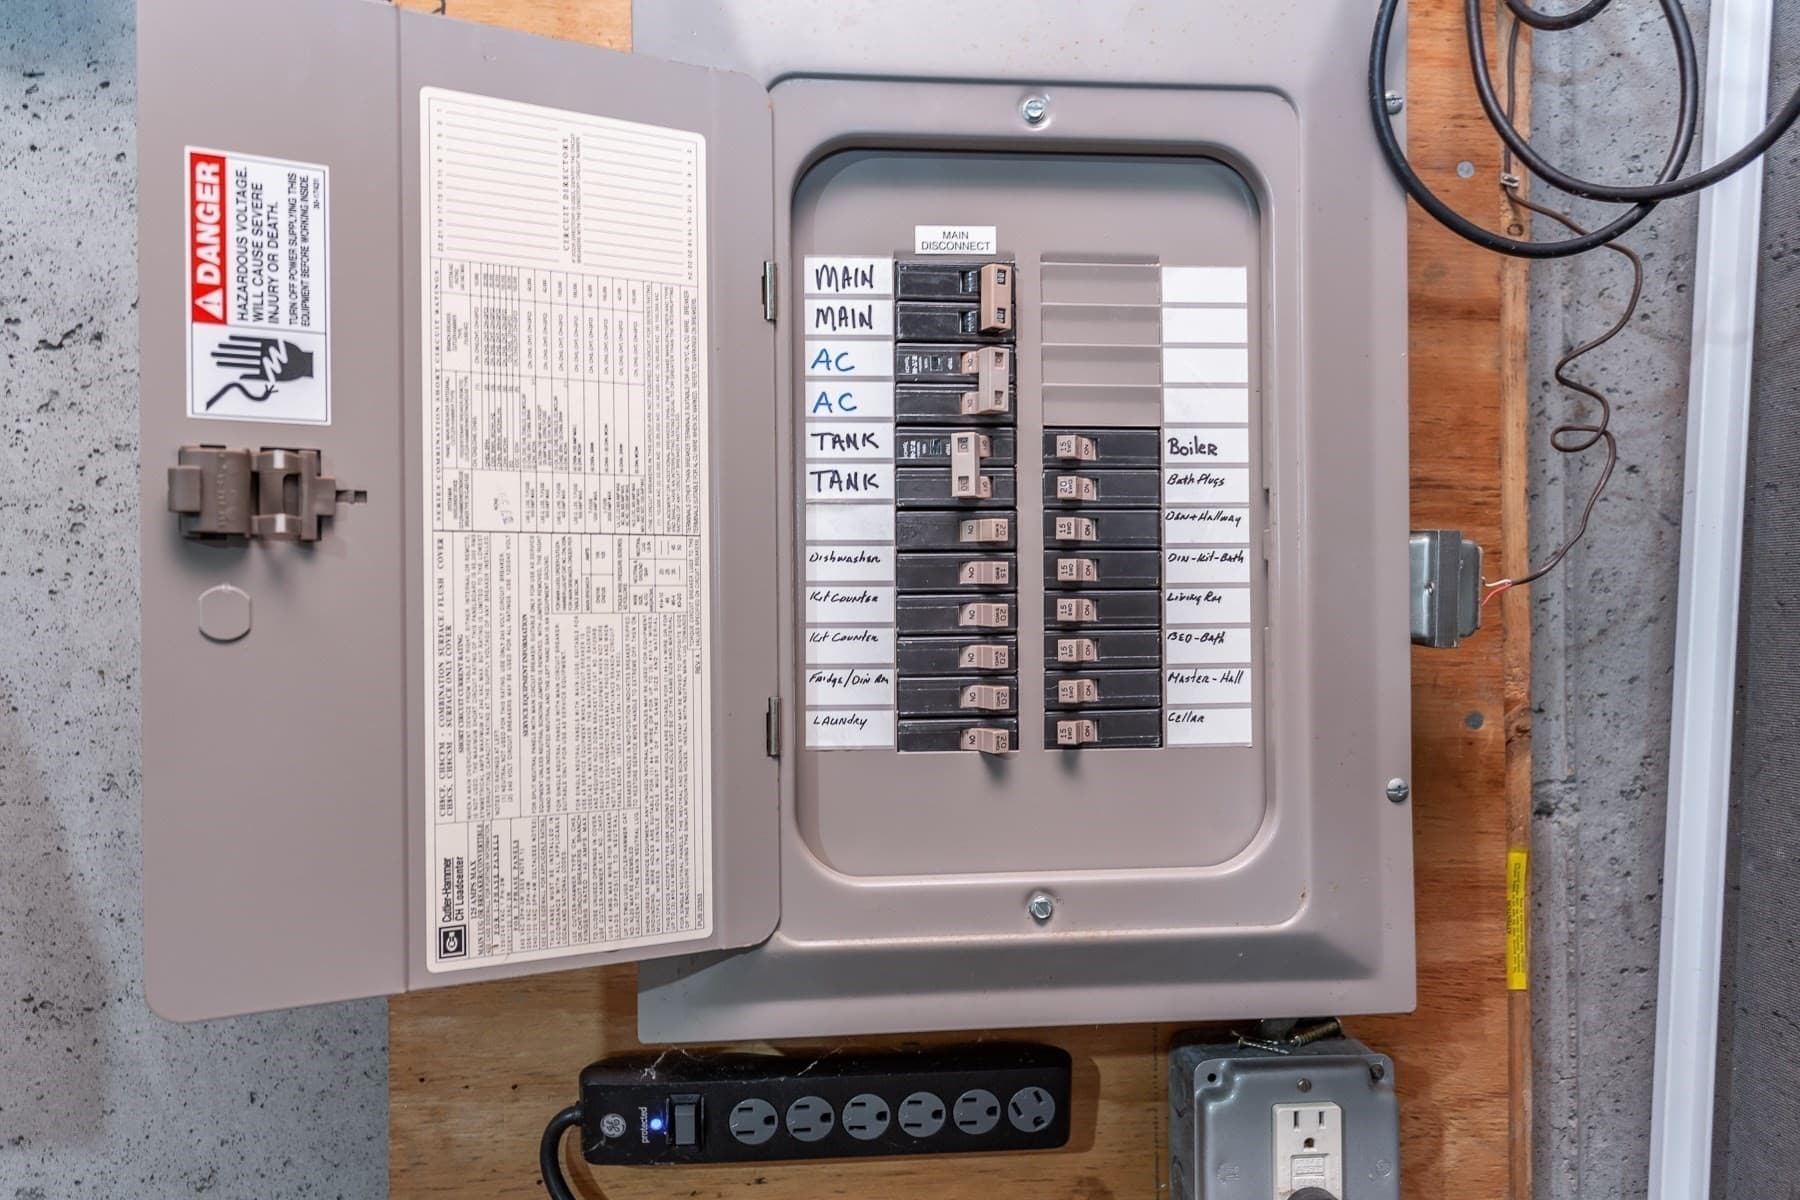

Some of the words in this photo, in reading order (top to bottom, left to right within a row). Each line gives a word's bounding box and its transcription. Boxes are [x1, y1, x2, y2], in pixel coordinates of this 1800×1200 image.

[287, 173, 297, 195] THIS
[251, 183, 263, 236] SEVERE
[195, 162, 221, 286] DANGER
[267, 202, 278, 249] DEATH.
[288, 198, 297, 246] SUPPLYING
[300, 205, 309, 243] WORKING
[922, 241, 989, 250] DISCONNECT
[252, 240, 264, 286] CAUSE
[268, 253, 279, 273] OR
[288, 249, 298, 281] POWER
[300, 245, 309, 278] BEFORE
[236, 237, 248, 321] HAZARDOUS
[816, 264, 873, 292] MAIN
[289, 283, 298, 300] OFF
[268, 276, 279, 324] INJURY
[301, 280, 310, 327] EQUIPMENT
[252, 291, 264, 322] WILL
[289, 302, 298, 325] TURN
[816, 305, 872, 331] MAIN
[811, 349, 855, 372] AC
[813, 392, 857, 413] AC
[811, 433, 879, 451] TANK
[1060, 442, 1066, 451] 15
[1084, 444, 1089, 455] ON
[809, 470, 879, 492] TANK
[1060, 481, 1067, 493] 20
[1084, 484, 1089, 493] ON
[968, 525, 974, 534] ON
[1000, 525, 1006, 535] 20
[1059, 524, 1066, 533] 15
[1085, 524, 1090, 536] ON
[969, 567, 974, 578] ON
[1001, 569, 1006, 577] 15
[1061, 565, 1067, 574] 15
[1086, 565, 1090, 576] ON
[969, 610, 975, 619] ON
[1000, 609, 1006, 621] 20
[1060, 605, 1067, 614] 15
[1085, 605, 1090, 615] ON
[1061, 646, 1067, 655] 15
[1085, 645, 1090, 655] ON
[968, 653, 974, 662] ON
[1000, 652, 1005, 664] 20
[1062, 688, 1068, 696] 15
[1086, 685, 1091, 696] ON
[970, 692, 975, 702] ON
[1001, 692, 1007, 704] 20
[1060, 728, 1066, 738] 15
[1085, 726, 1090, 737] ON
[969, 735, 975, 744] ON
[1001, 736, 1007, 748] 20
[455, 857, 464, 906] Loadcenter
[442, 857, 452, 923] Cutler-Hammer
[455, 908, 464, 921] CH
[478, 910, 484, 919] OR
